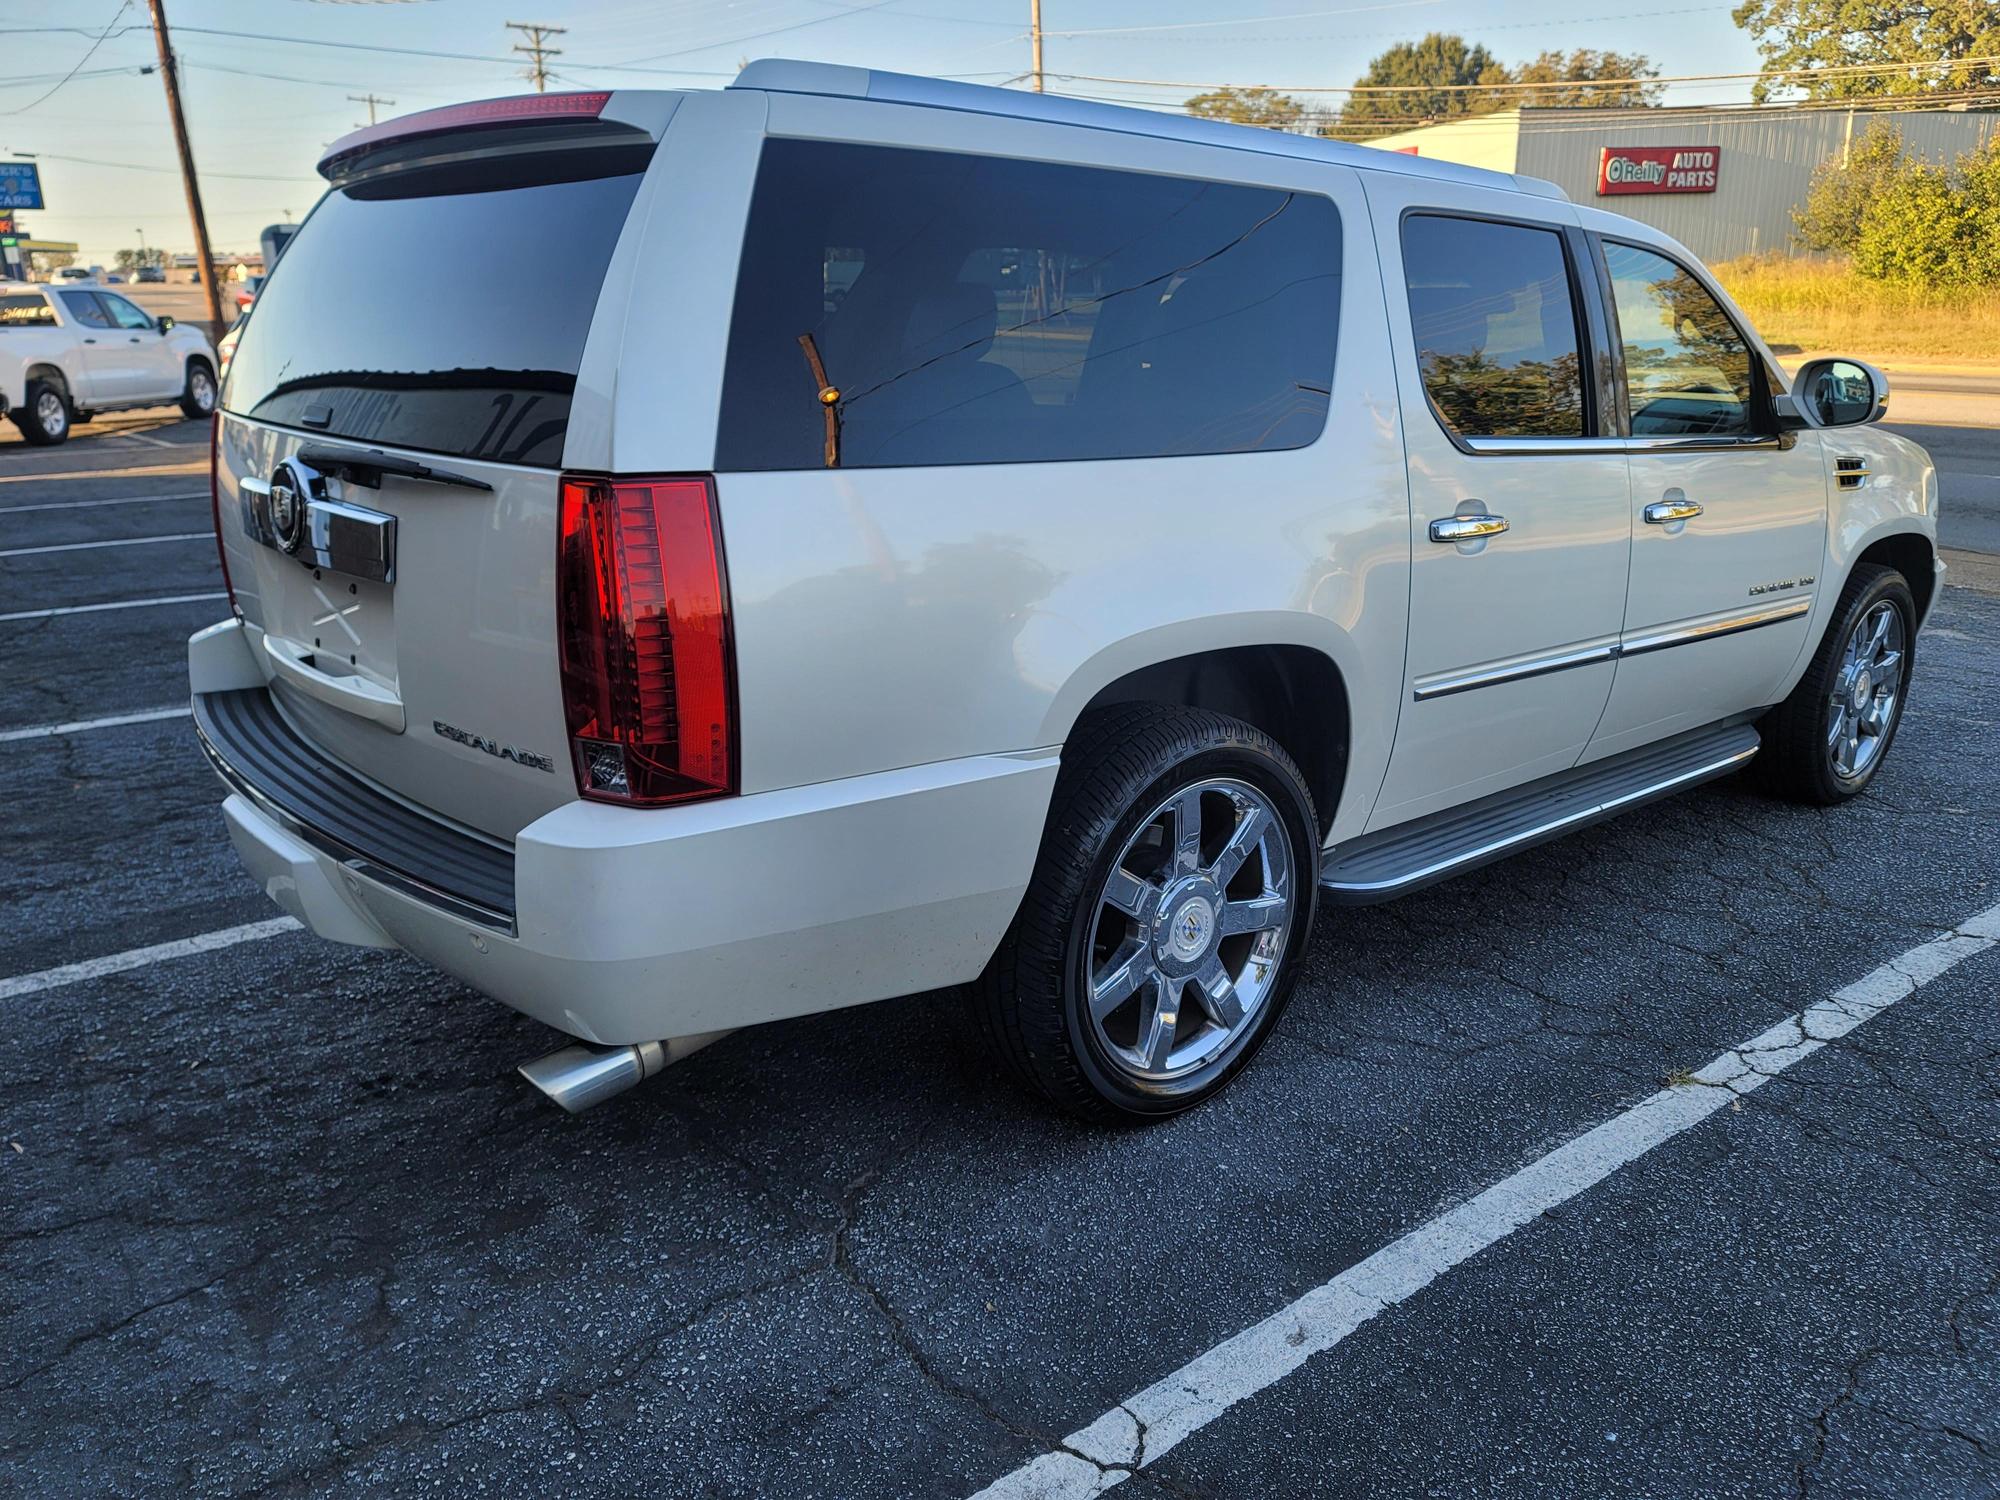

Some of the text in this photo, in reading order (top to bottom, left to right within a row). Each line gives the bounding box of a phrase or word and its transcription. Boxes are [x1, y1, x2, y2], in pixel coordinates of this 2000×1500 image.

[1673, 152, 1713, 169] AUTO
[1606, 157, 1666, 184] O'Reilly
[1667, 171, 1715, 187] PARTS
